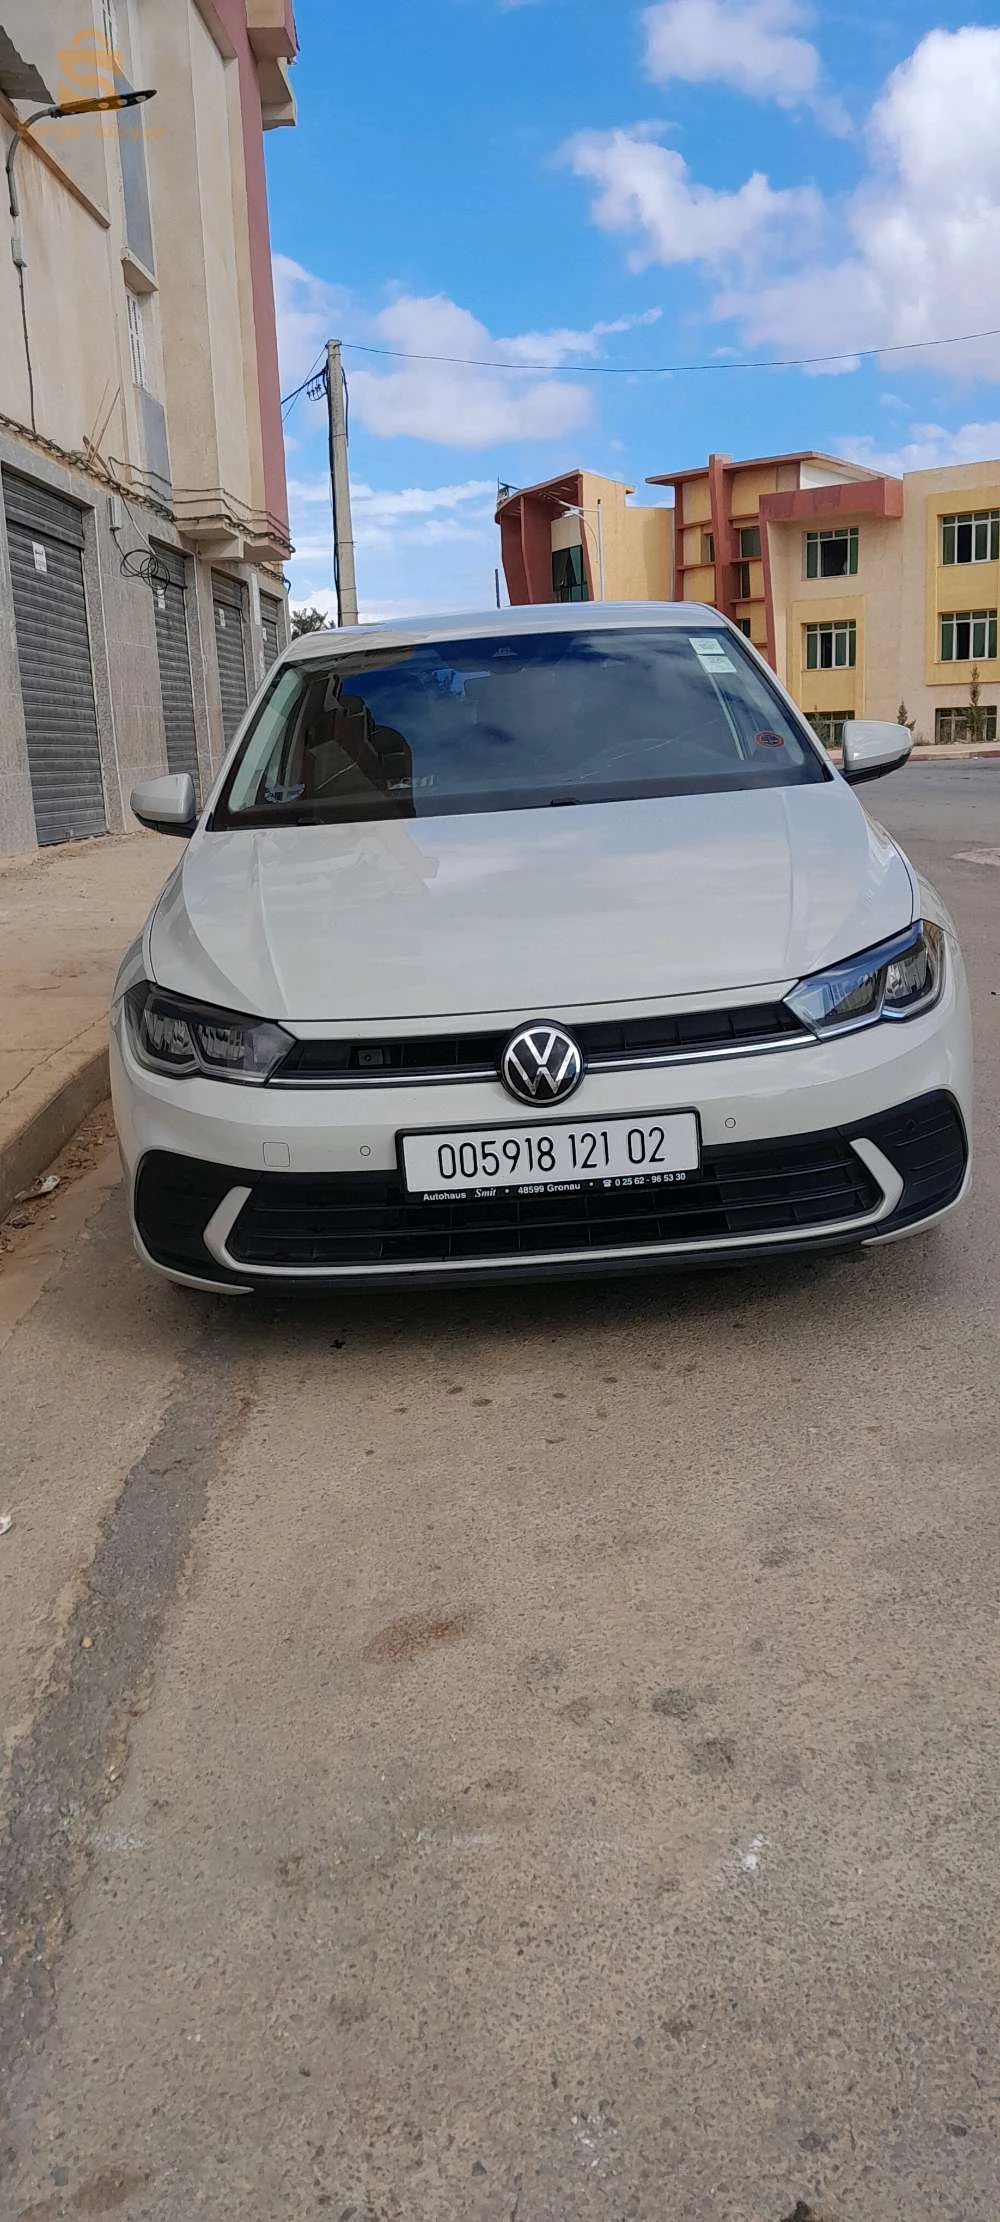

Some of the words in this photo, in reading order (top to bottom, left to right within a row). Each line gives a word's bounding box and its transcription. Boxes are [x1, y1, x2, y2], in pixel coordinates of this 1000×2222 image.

[437, 1136, 556, 1179] 005918
[568, 1130, 609, 1169] 121
[627, 1126, 666, 1164] 02
[423, 1191, 467, 1201] Autohaus
[474, 1188, 497, 1198] Smit
[518, 1185, 544, 1194] 48599
[546, 1183, 581, 1192] Gronau
[675, 1172, 687, 1181] 30
